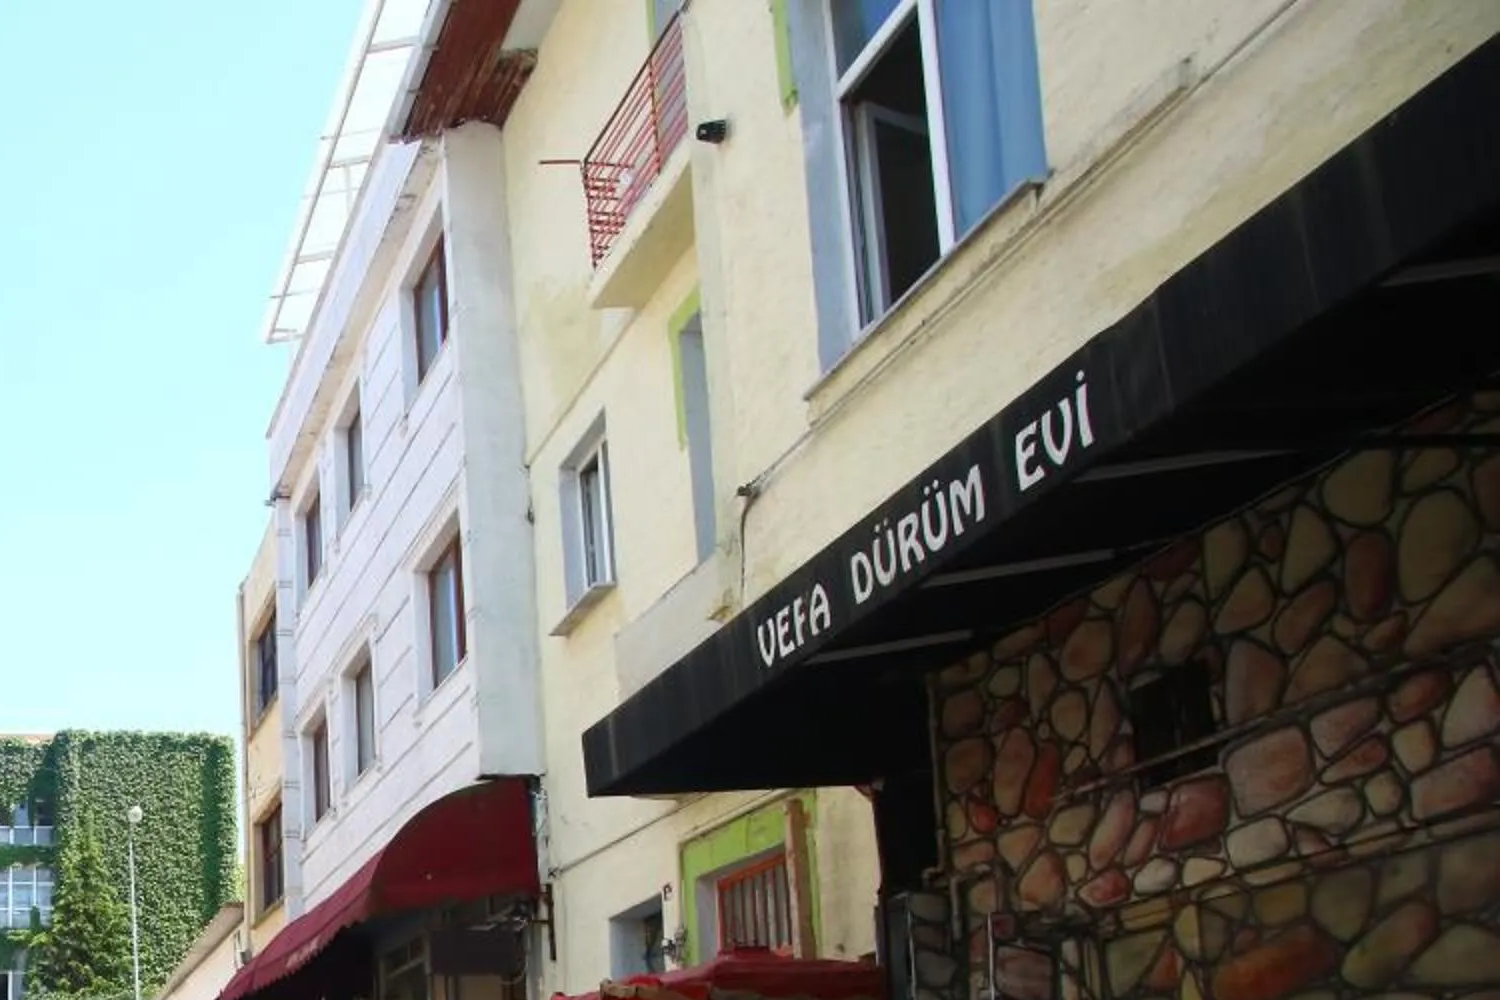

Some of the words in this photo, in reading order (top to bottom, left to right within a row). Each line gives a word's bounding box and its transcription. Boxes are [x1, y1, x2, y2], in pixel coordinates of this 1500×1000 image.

[757, 583, 831, 668] VEFA
[851, 464, 986, 604] DÜRÜM
[1015, 370, 1095, 491] EVİ
